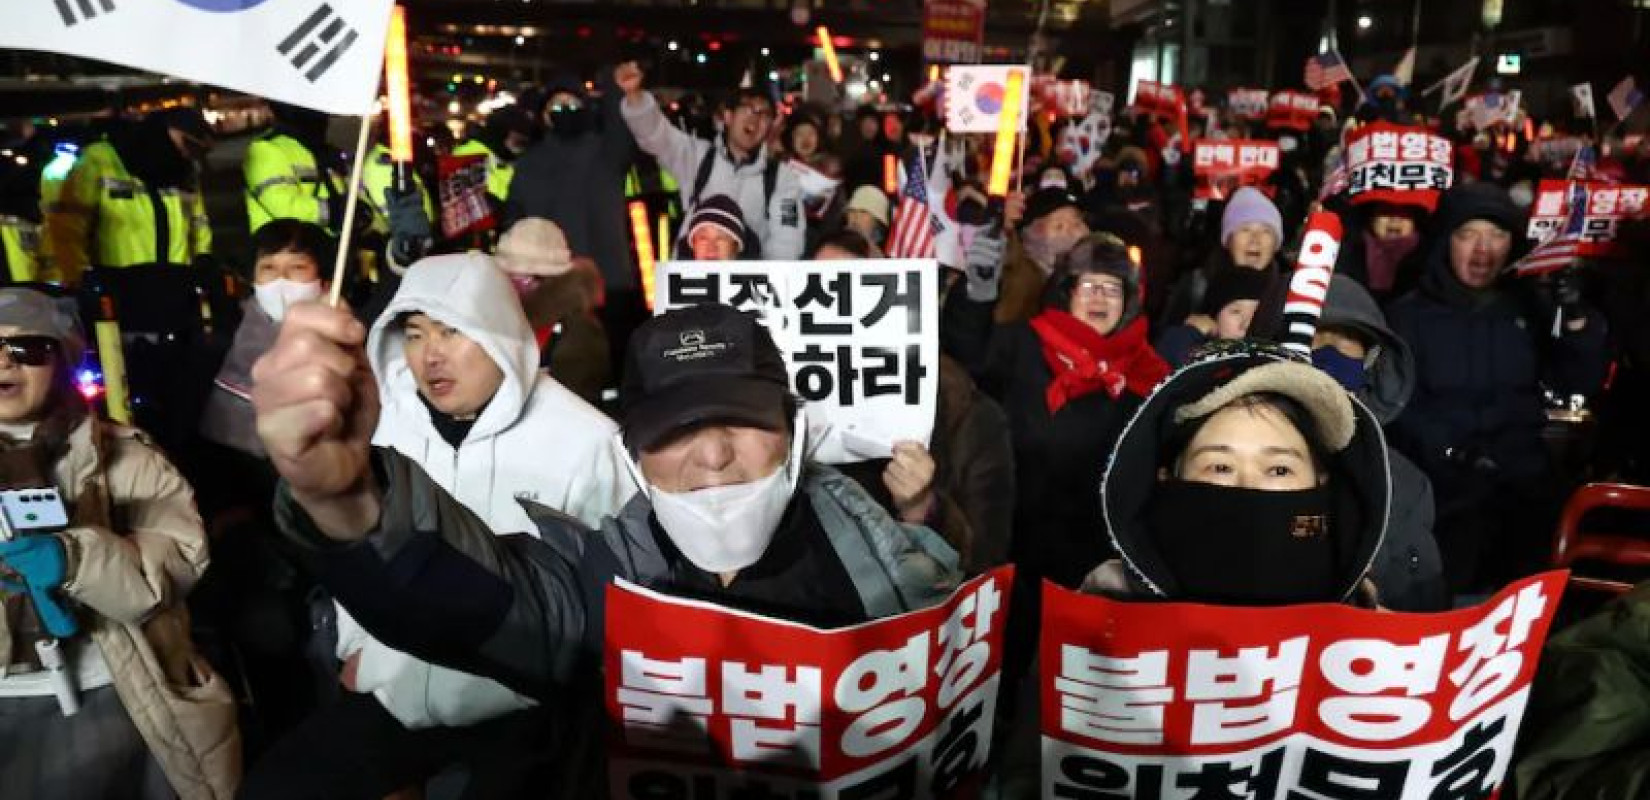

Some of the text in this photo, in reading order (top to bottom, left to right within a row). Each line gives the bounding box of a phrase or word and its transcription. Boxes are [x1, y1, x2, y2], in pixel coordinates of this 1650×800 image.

[1537, 188, 1647, 215] 불영장
[794, 271, 922, 335] 선거
[617, 577, 1000, 769] 불법영장
[1055, 581, 1547, 745] 불법영장
